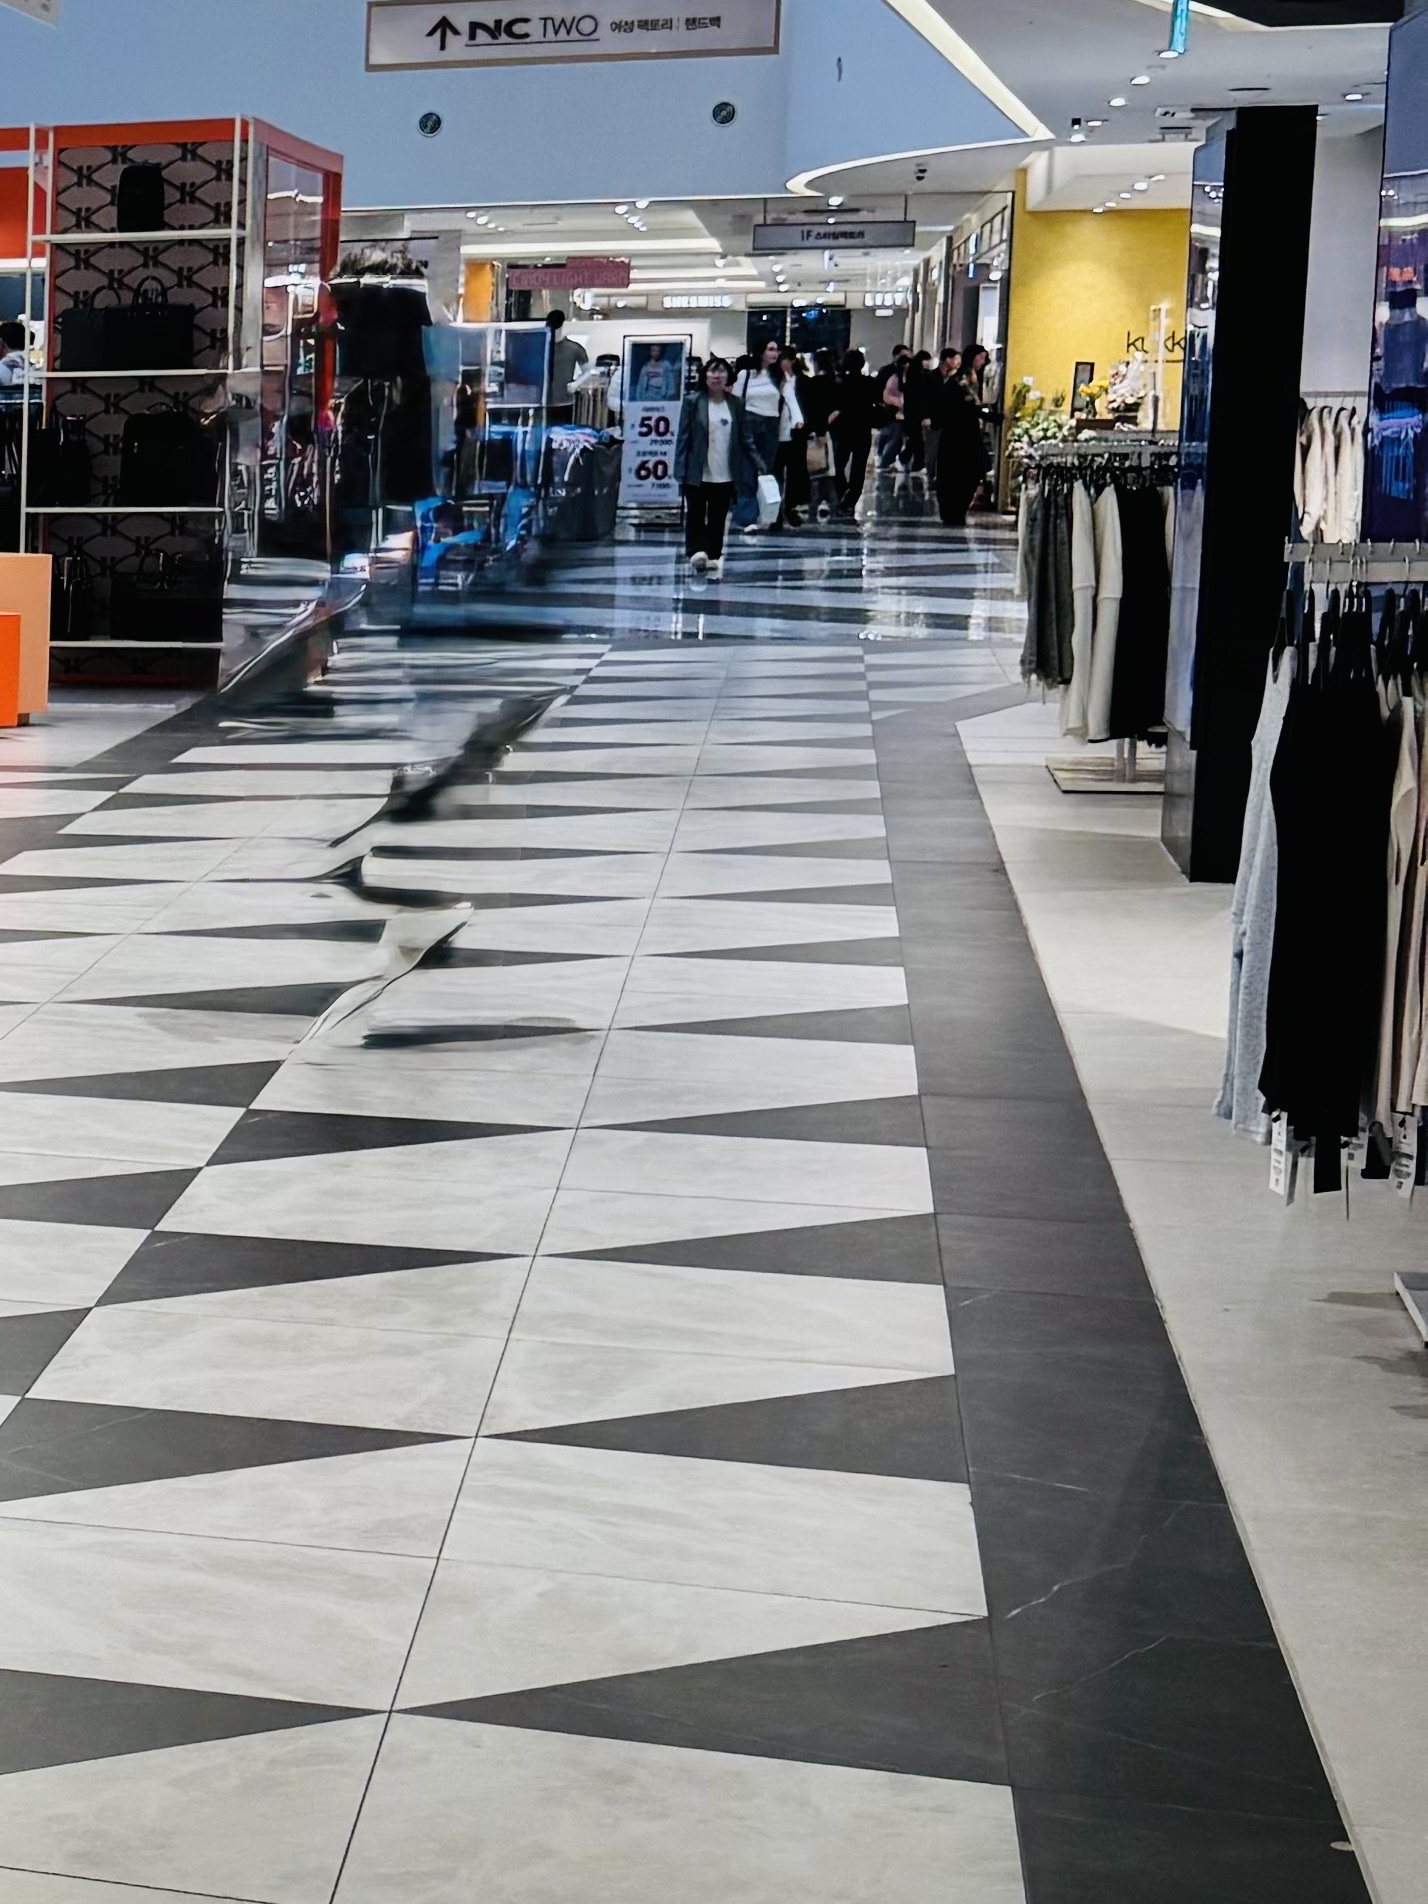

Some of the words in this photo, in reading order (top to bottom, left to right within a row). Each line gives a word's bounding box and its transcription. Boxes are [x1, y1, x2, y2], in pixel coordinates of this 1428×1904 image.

[467, 18, 533, 41] NC
[538, 14, 599, 39] TWO
[610, 19, 635, 34] 여성
